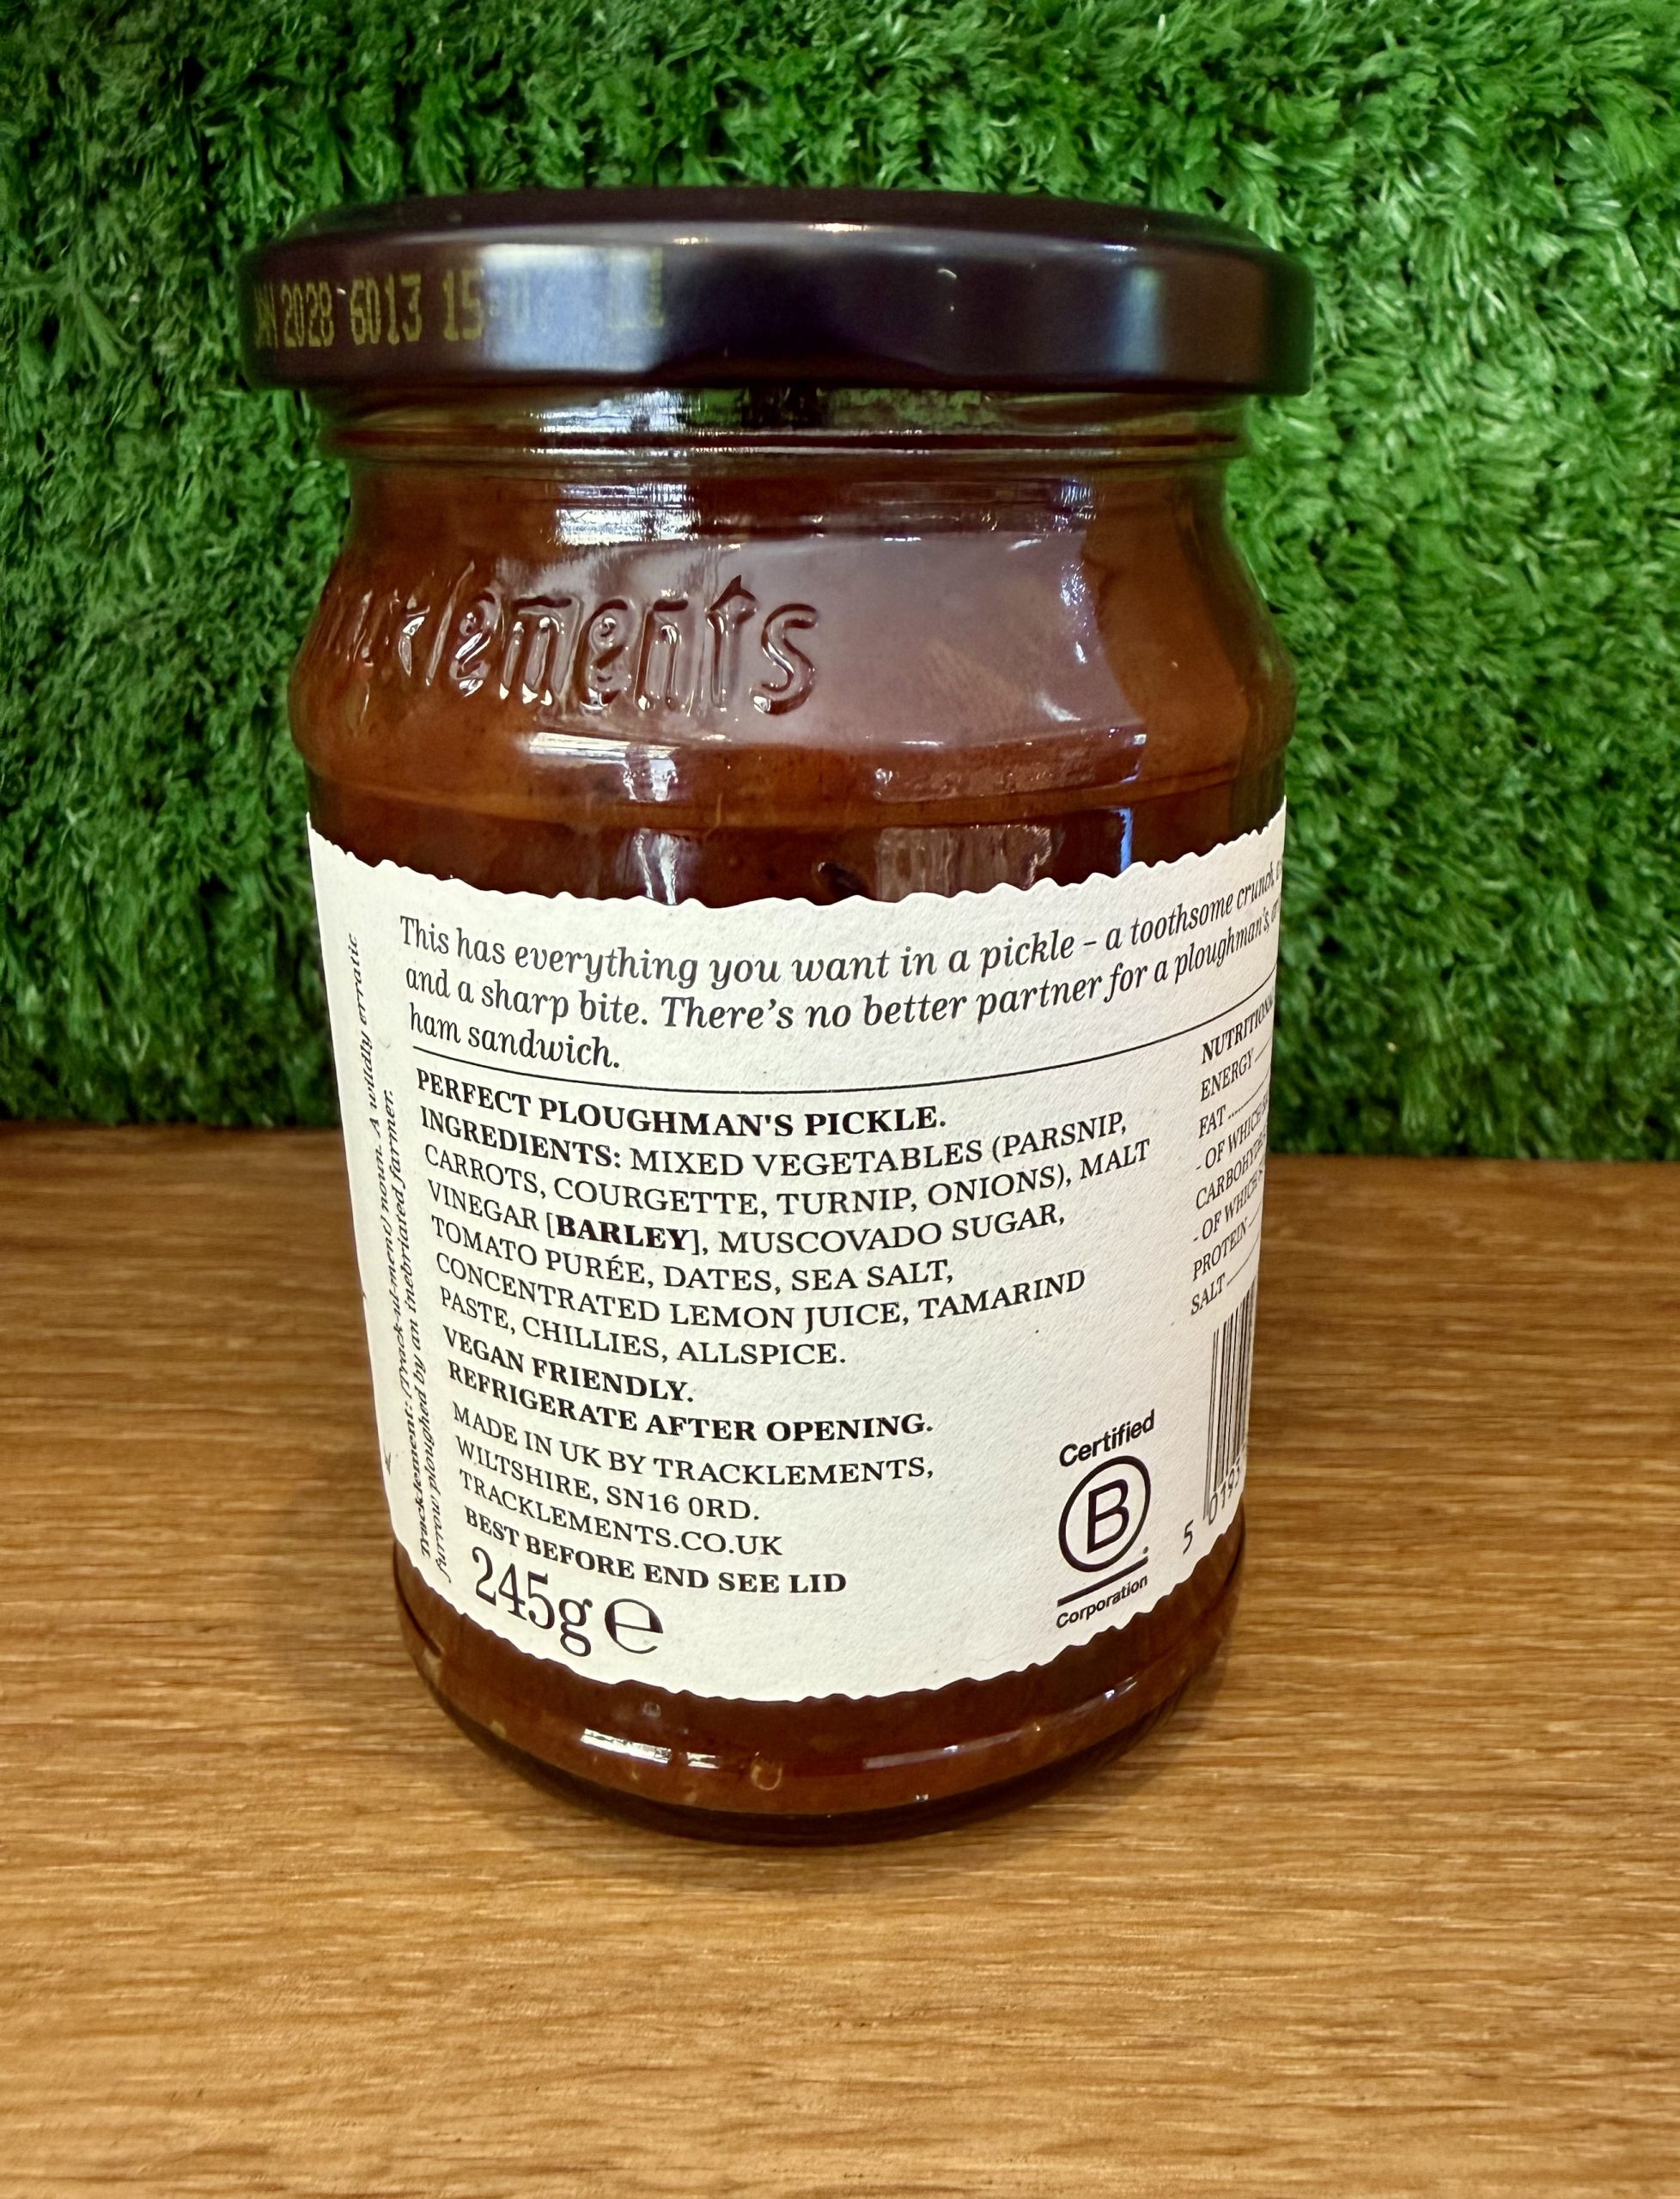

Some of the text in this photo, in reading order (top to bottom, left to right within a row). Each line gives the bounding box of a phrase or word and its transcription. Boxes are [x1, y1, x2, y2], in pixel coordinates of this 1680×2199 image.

[281, 281, 335, 348] 2028
[350, 271, 423, 345] 6013
[347, 932, 368, 1026] erratic
[400, 916, 448, 954] This
[456, 928, 505, 964] has
[515, 947, 697, 989] everything
[709, 959, 781, 990] you
[791, 950, 890, 982] want
[900, 946, 937, 977] in
[948, 950, 971, 973] a
[980, 929, 1074, 978] pickle
[1105, 928, 1123, 951] a
[1130, 892, 1233, 945] toothsome
[406, 968, 451, 998] and
[458, 981, 474, 1003] a
[482, 979, 569, 1025] sharp
[578, 990, 648, 1025] bite.
[661, 996, 794, 1029] There’s
[805, 1005, 851, 1028] no
[863, 994, 967, 1026] better
[976, 976, 1103, 1024] partner
[1104, 962, 1147, 1003] for
[1154, 959, 1168, 983] a
[359, 1029, 378, 1109] wildly
[410, 1002, 619, 1068] ham sandwich.
[417, 1068, 946, 1136] PERFECT PLOUGHMAN'S PICKLE.
[1201, 1048, 1253, 1101] ENERGY
[368, 1118, 382, 1138] A
[420, 1106, 1126, 1177] INGREDIENTS: MIXED VEGETABLES (PARSNIP,
[1199, 1104, 1226, 1139] FAT
[1205, 1140, 1226, 1169] OF
[374, 1145, 390, 1213] noun.
[424, 1138, 1150, 1219] CARROTS, COURGETTE, TURNIP, ONIONS), MALT
[428, 1179, 1064, 1256] VINEGAR [BARLEY], MUSCOVADO SUGAR,
[431, 1215, 953, 1295] TOMATO PURÉE, DATES, SEA SALT,
[1193, 1216, 1247, 1282] PROTEIN
[1202, 1210, 1221, 1240] OF
[436, 1249, 1086, 1334] CONCENTRATED LEMON JUICE, TAMARIND
[440, 1286, 845, 1365] PASTE, CHILLIES, ALLSPICE.
[1191, 1272, 1225, 1316] SALT
[384, 1089, 452, 1584] furrow ploughed by an inebriated farmer.
[442, 1325, 693, 1403] VEGAN FRIENDLY.
[447, 1359, 933, 1441] REFRIGERATE AFTER OPENING.
[1059, 1408, 1154, 1467] Certified
[403, 1402, 431, 1558] Tracklement:
[453, 1401, 933, 1485] MADE IN UK BY TRACKLEMENTS,
[455, 1435, 598, 1504] WILTSHIRE,
[606, 1486, 679, 1514] SN16
[460, 1469, 782, 1556] TRACKLEMENTS.CO.UK
[465, 1505, 846, 1593] BEST BEFORE END SEE LID
[1087, 1479, 1129, 1554] B
[1183, 1520, 1194, 1555] 5
[472, 1546, 593, 1657] 245g
[1056, 1575, 1147, 1629] Corporation
